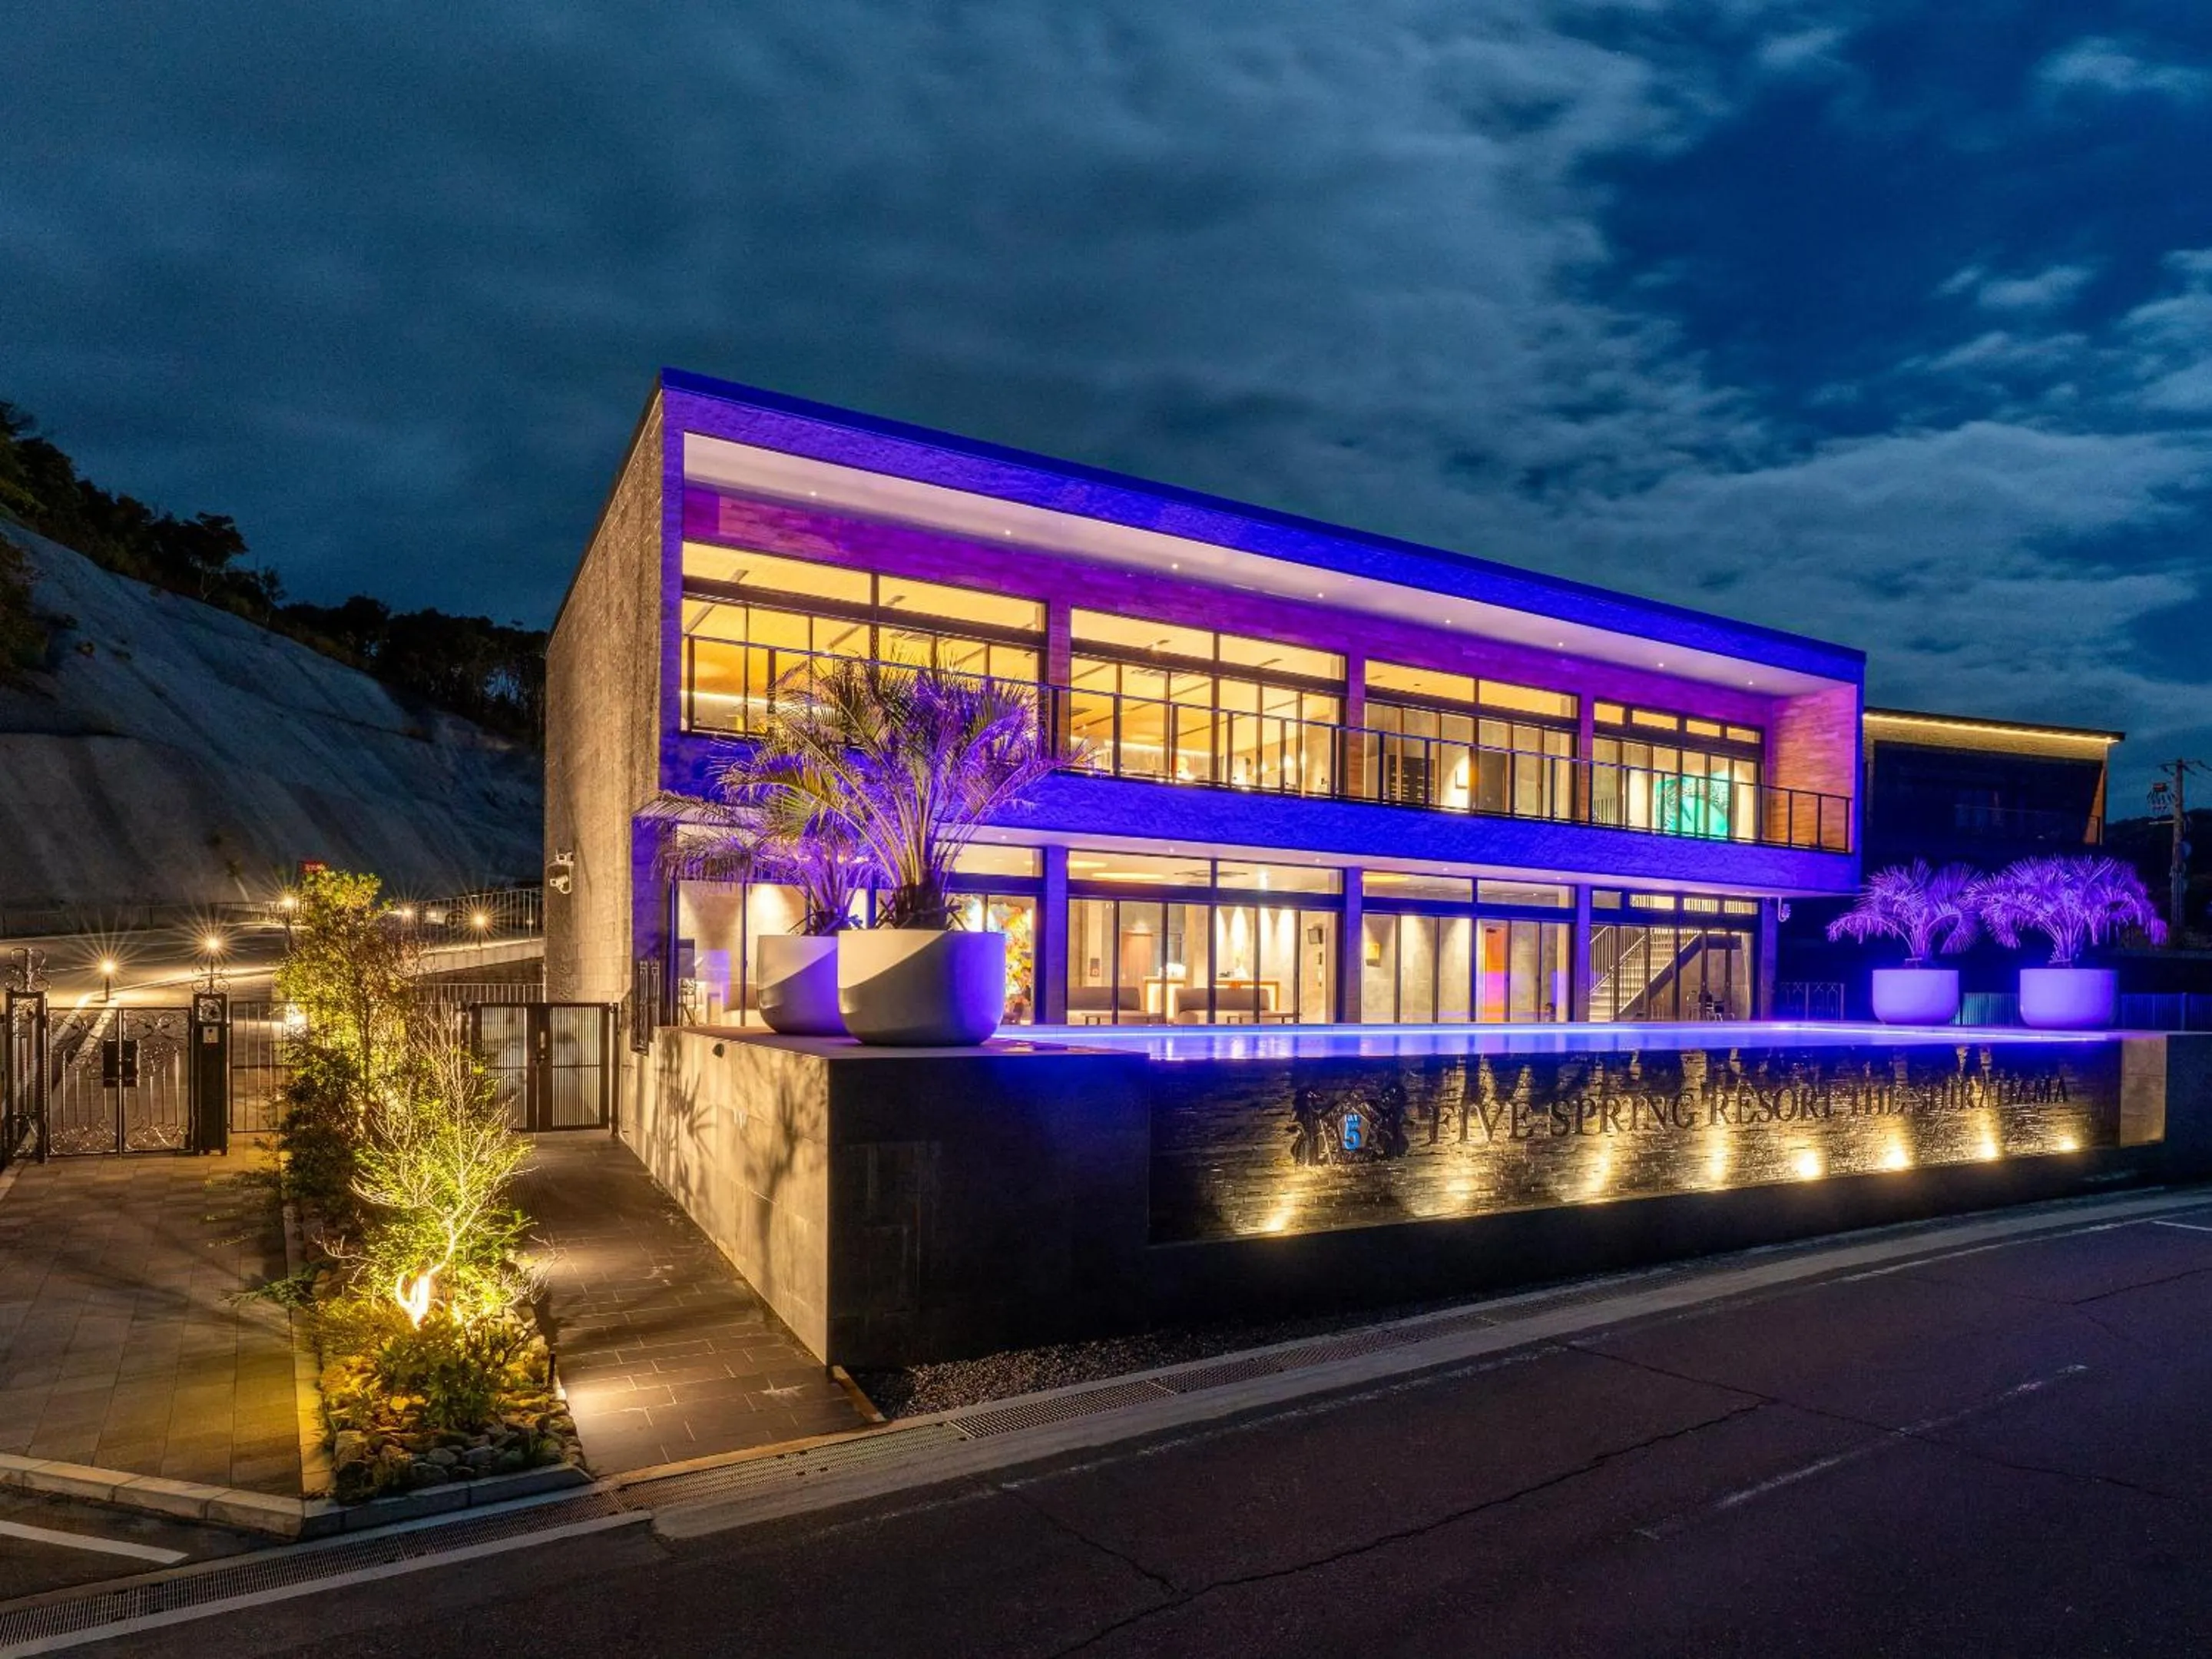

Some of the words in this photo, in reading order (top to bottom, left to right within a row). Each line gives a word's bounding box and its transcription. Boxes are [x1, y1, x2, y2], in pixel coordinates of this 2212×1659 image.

[1429, 1098, 1534, 1144] FIVE
[1550, 1091, 1696, 1137] SPRING
[1710, 1084, 1839, 1125] RESORT
